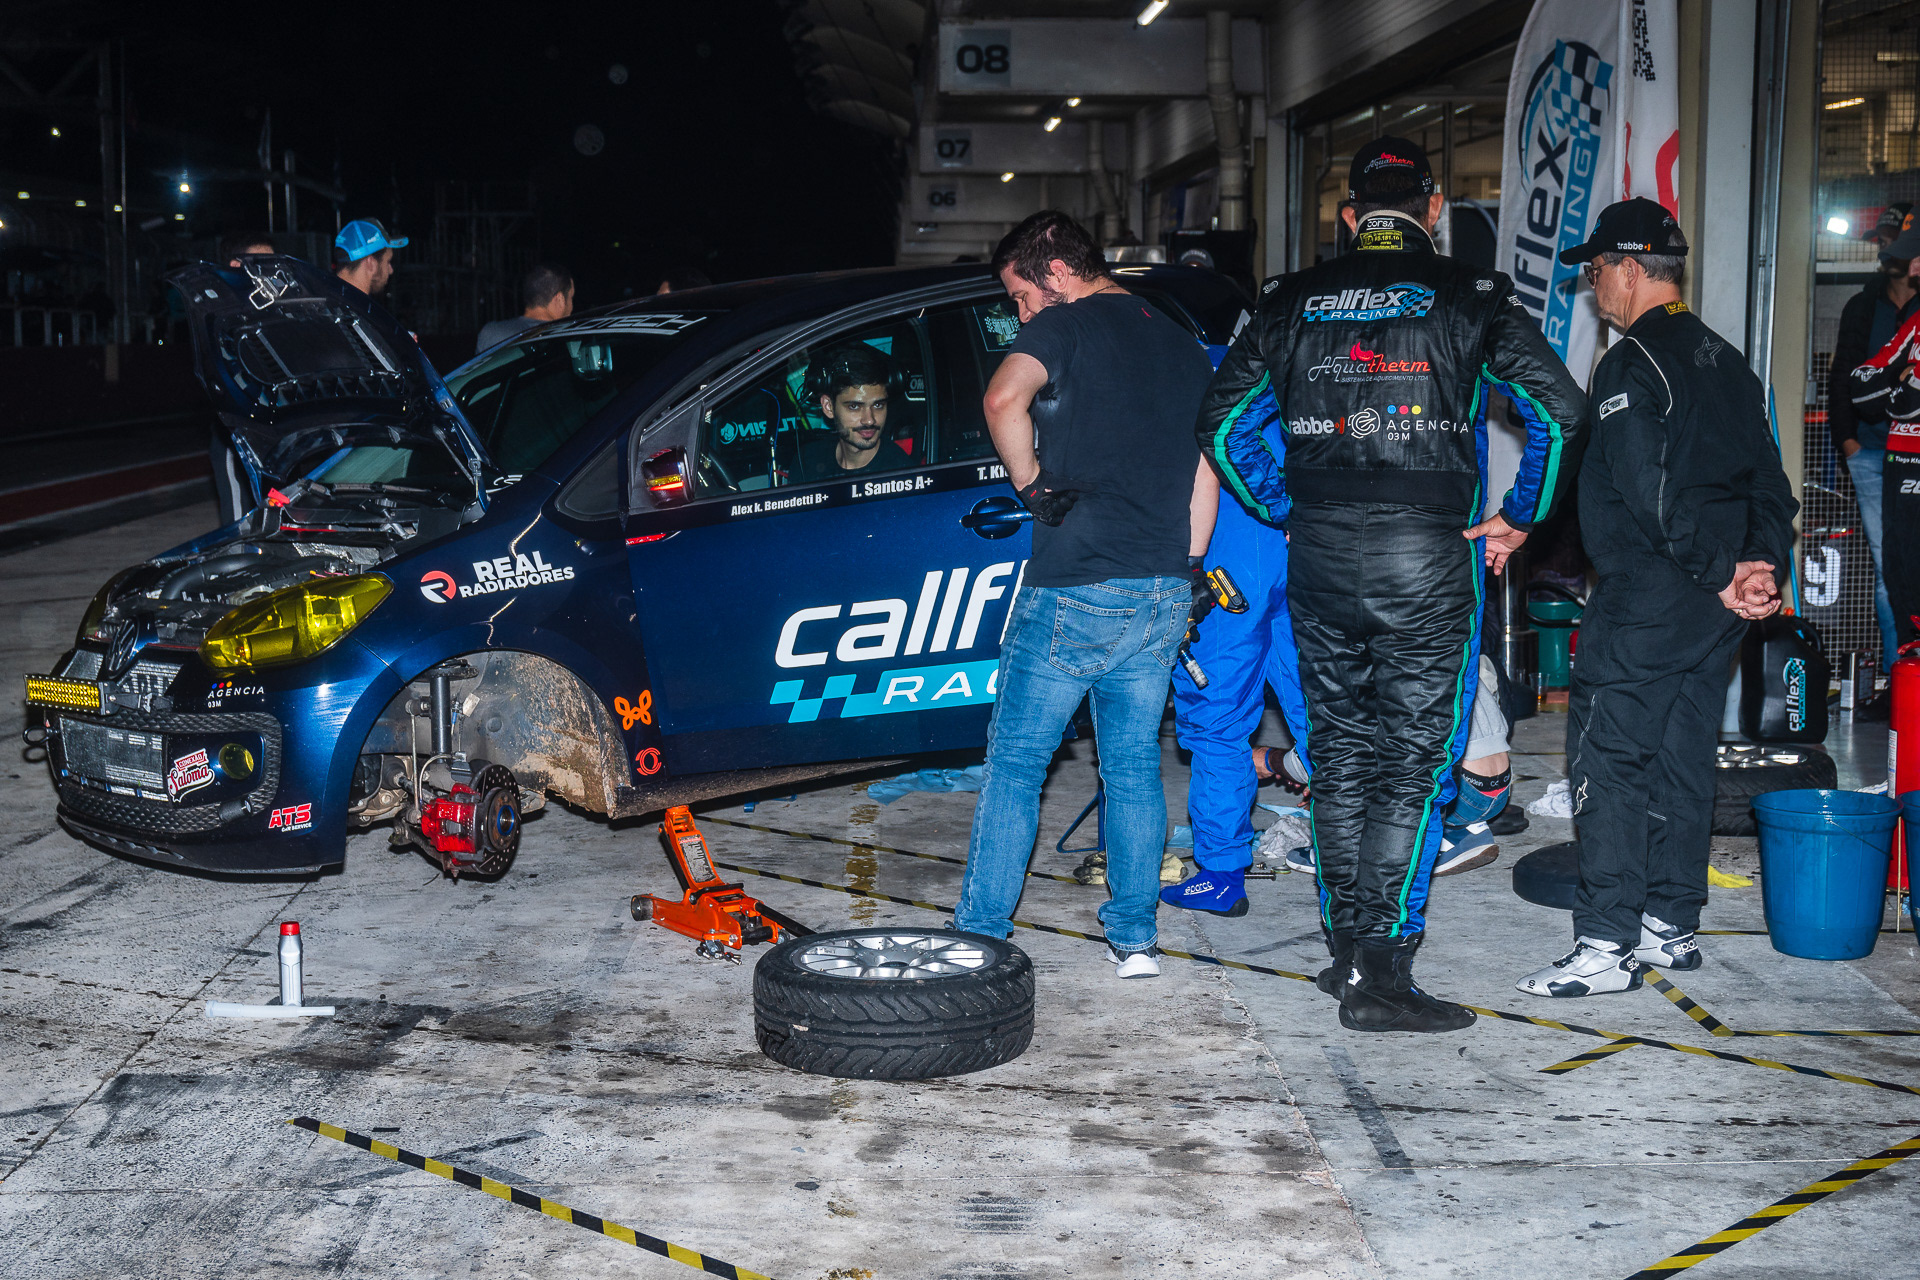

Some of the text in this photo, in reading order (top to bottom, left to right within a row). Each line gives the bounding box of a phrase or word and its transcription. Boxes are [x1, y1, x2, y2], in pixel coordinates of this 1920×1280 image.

[956, 44, 1010, 74] 08
[936, 139, 970, 158] 07
[929, 191, 956, 206] 06
[1617, 242, 1644, 250] trabbe
[1304, 288, 1407, 311] callflex
[1330, 308, 1398, 320] RACING
[1307, 354, 1431, 381] Aquatherm
[1288, 416, 1334, 434] rabbe
[1386, 419, 1469, 434] AGENCIA
[977, 467, 988, 480] T.
[851, 475, 934, 498] L. Santos A+
[731, 504, 753, 516] Alex
[764, 494, 813, 512] Benedetti
[815, 493, 829, 504] B+
[472, 550, 552, 583] REAL
[458, 566, 575, 598] RADIADORES
[207, 686, 264, 699] AGENCIA
[207, 700, 222, 708] 03M
[269, 802, 312, 829] ATS
[292, 823, 312, 831] SERVICE
